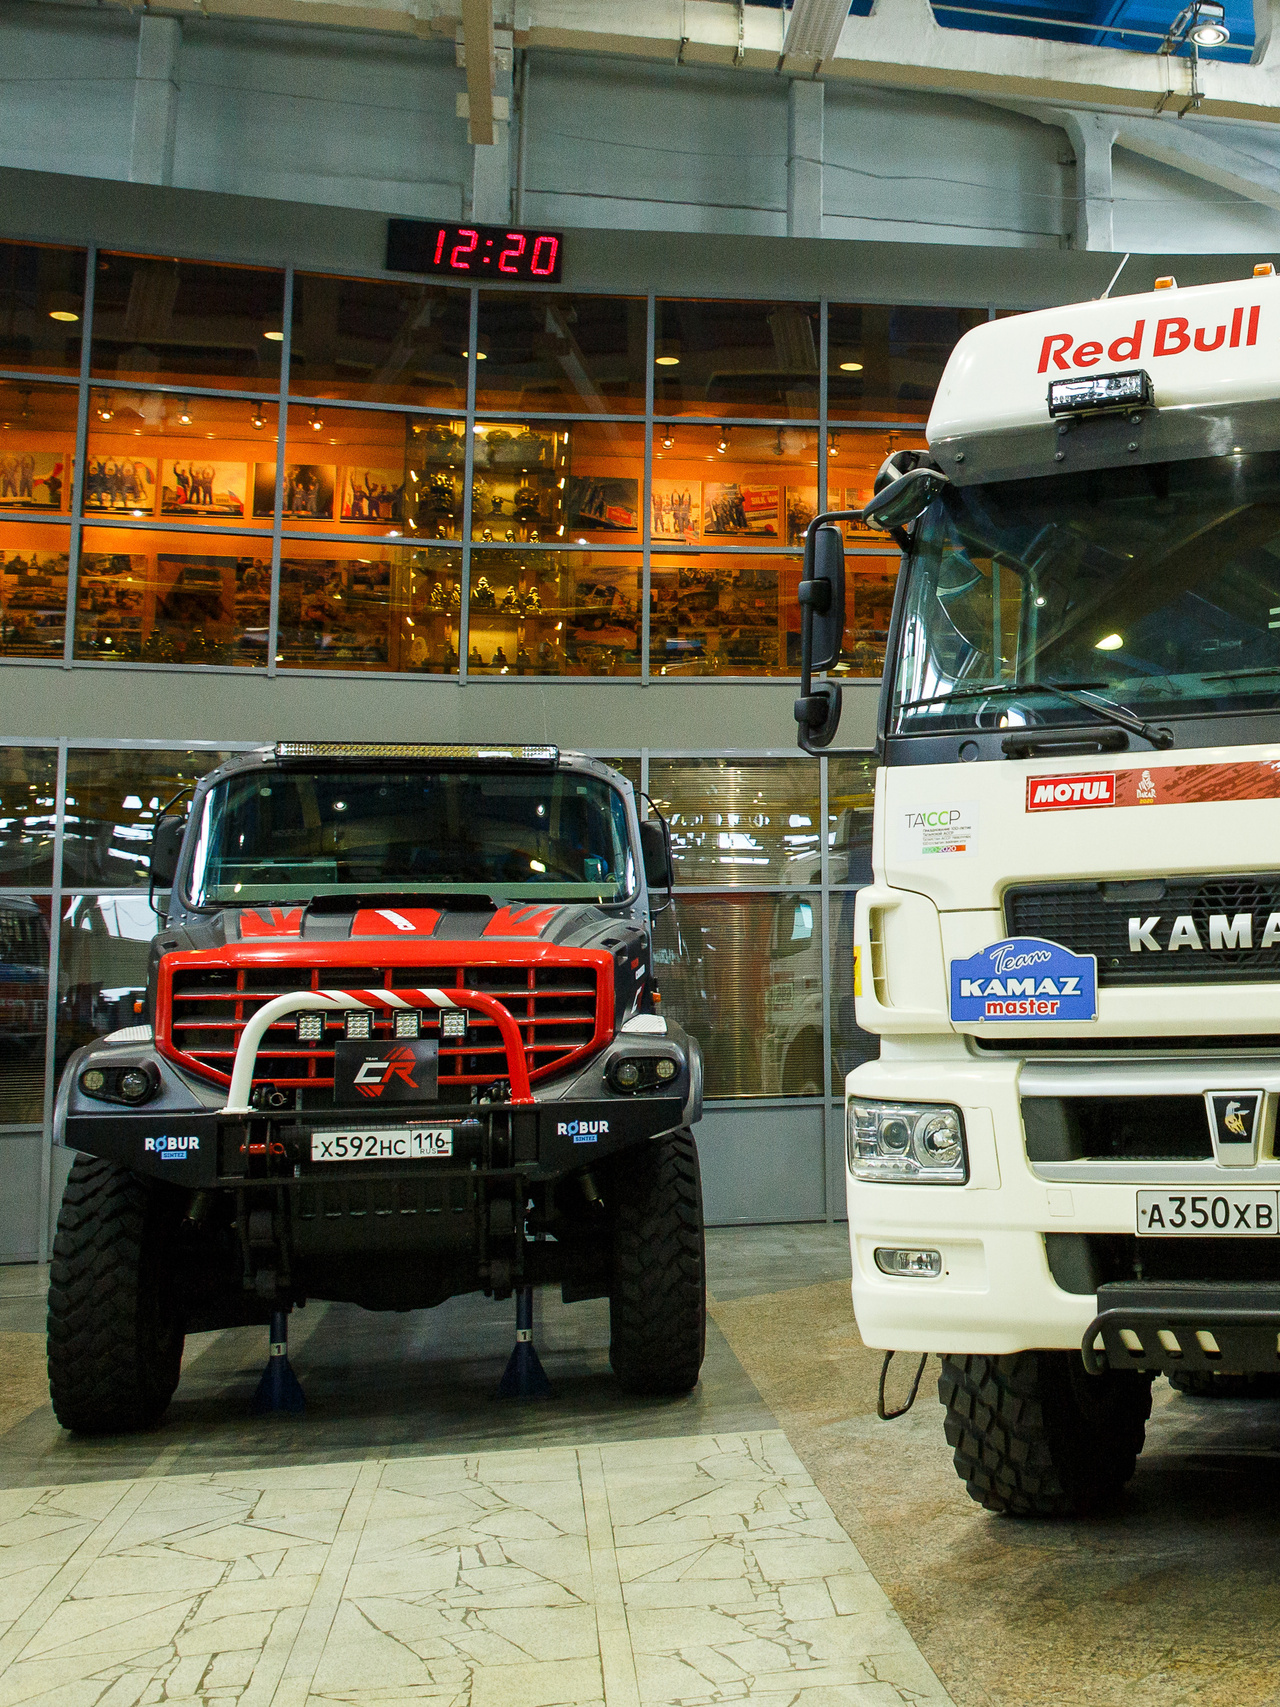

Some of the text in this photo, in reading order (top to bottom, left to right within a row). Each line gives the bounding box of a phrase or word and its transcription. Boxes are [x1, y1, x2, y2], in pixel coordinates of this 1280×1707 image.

[434, 229, 559, 275] 12:20
[1037, 305, 1261, 373] Red Bull
[1033, 781, 1110, 803] MOTUL
[989, 944, 1051, 975] Team
[960, 977, 1081, 997] KAMAZ
[985, 998, 1060, 1015] master
[414, 1132, 446, 1149] 116
